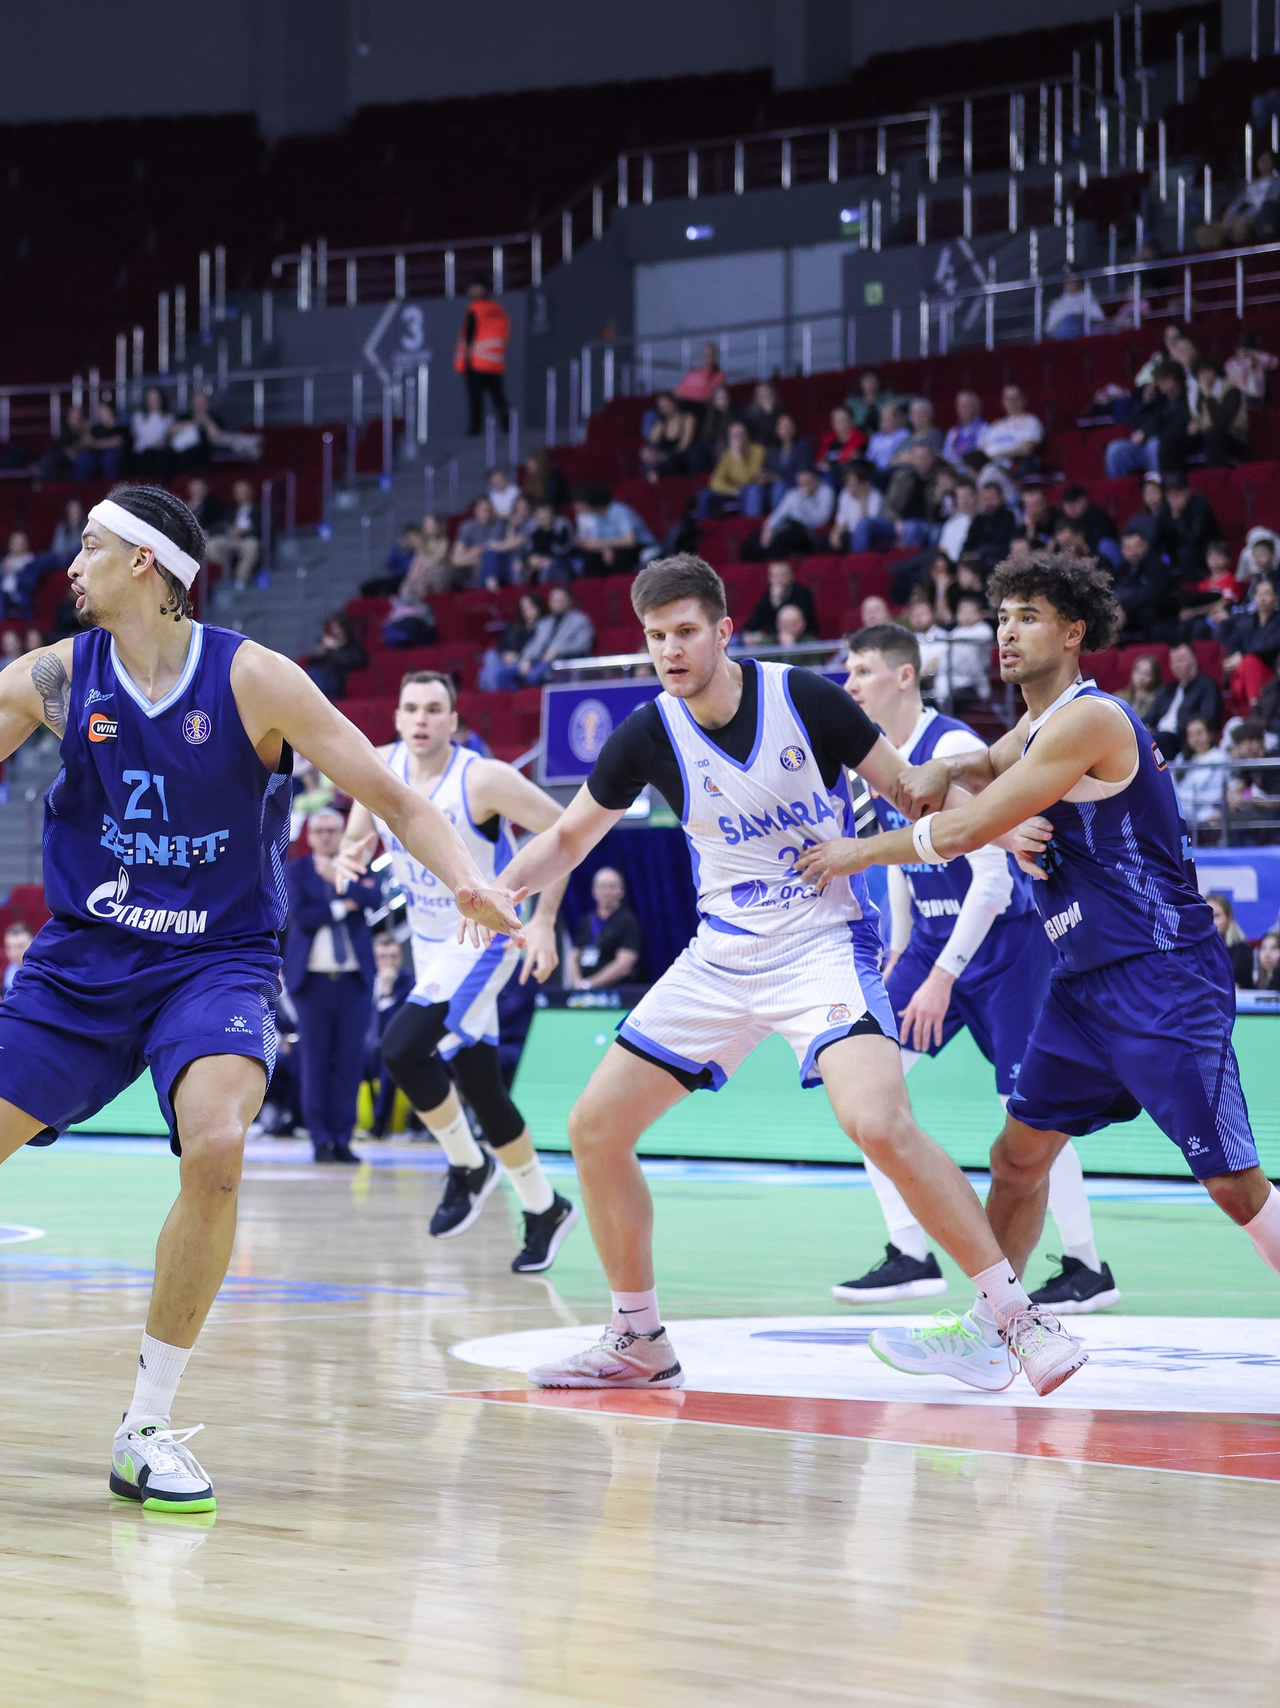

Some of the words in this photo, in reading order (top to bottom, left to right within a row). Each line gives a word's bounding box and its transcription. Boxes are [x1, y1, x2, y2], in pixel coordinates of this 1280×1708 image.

[400, 305, 425, 350] 3
[122, 769, 170, 823] 21
[718, 791, 836, 846] SAMARA
[100, 812, 230, 869] ZENIT
[406, 861, 437, 888] 16
[116, 904, 208, 935] ГАЗПРОМ
[224, 1026, 254, 1036] KELME
[1187, 1146, 1210, 1158] KELME
